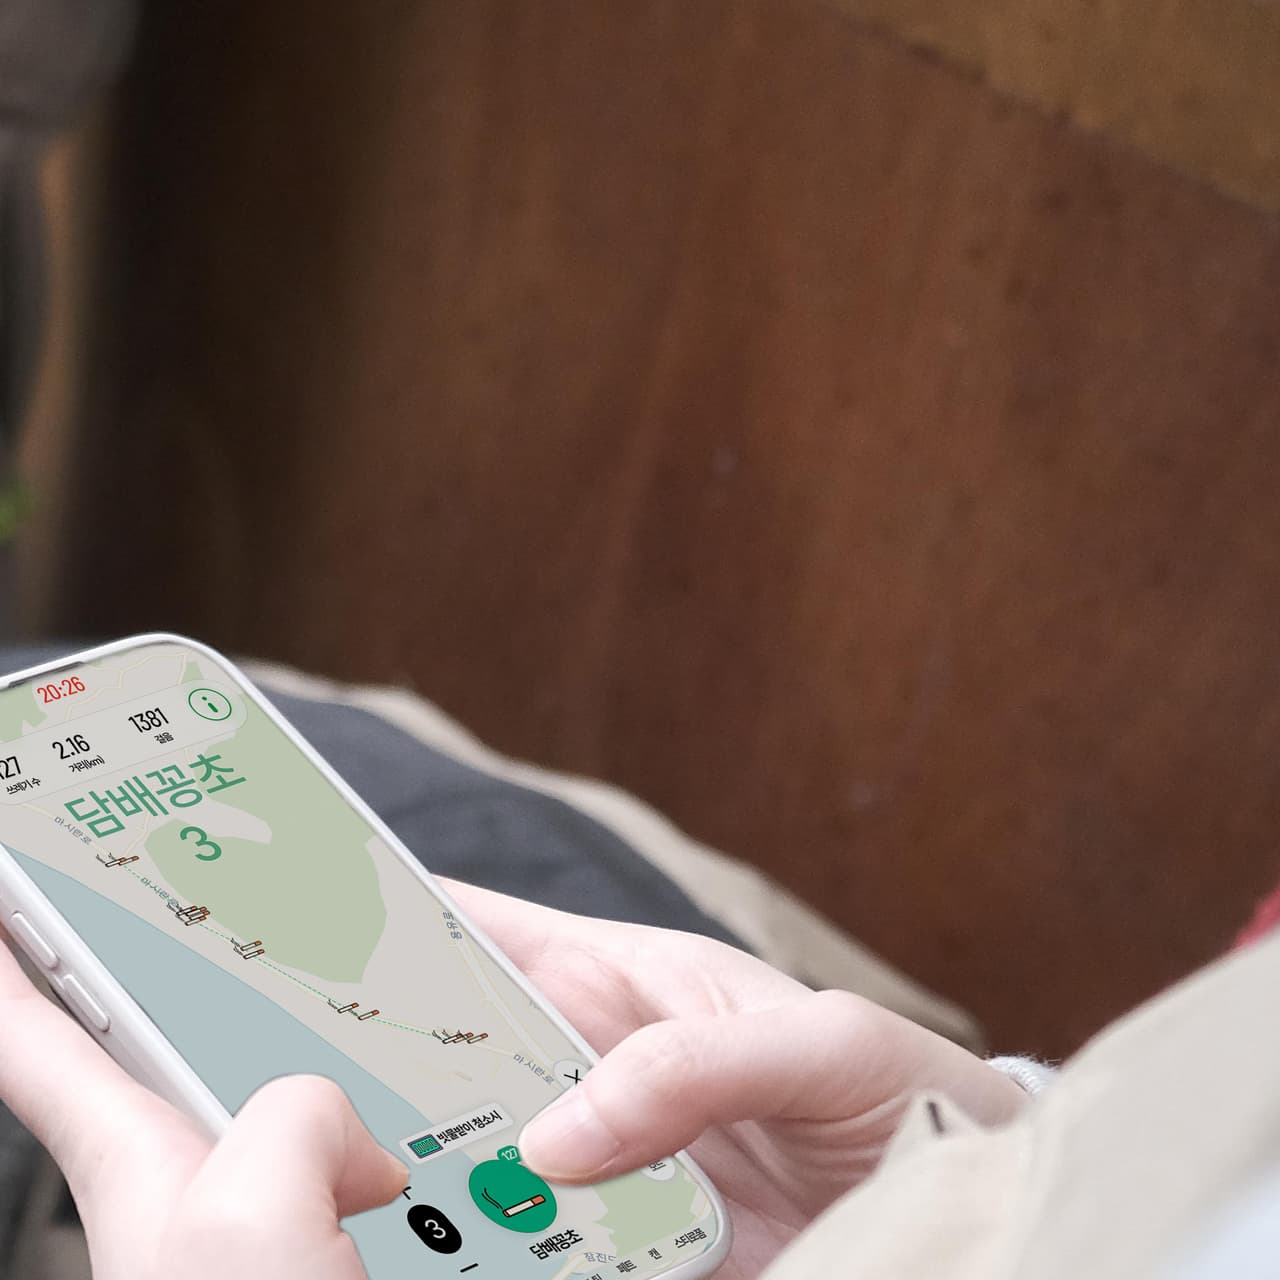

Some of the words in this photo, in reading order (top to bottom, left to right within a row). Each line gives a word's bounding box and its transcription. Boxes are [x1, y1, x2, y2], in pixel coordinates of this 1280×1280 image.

[37, 676, 86, 704] 20:26
[128, 707, 170, 733] 1381
[52, 734, 91, 759] 2.16
[154, 732, 174, 744] 걸음
[68, 755, 106, 773] 거리(km)
[63, 753, 247, 838] 담배꽁초
[179, 826, 222, 861] 3
[436, 1121, 476, 1144] 빗물받이
[471, 1110, 503, 1129] 청소시
[425, 1219, 446, 1239] 3
[529, 1228, 584, 1260] 담배꽁초
[615, 1260, 637, 1273] 페트
[647, 1247, 663, 1260] 캔
[674, 1227, 707, 1249] 스티로폼
